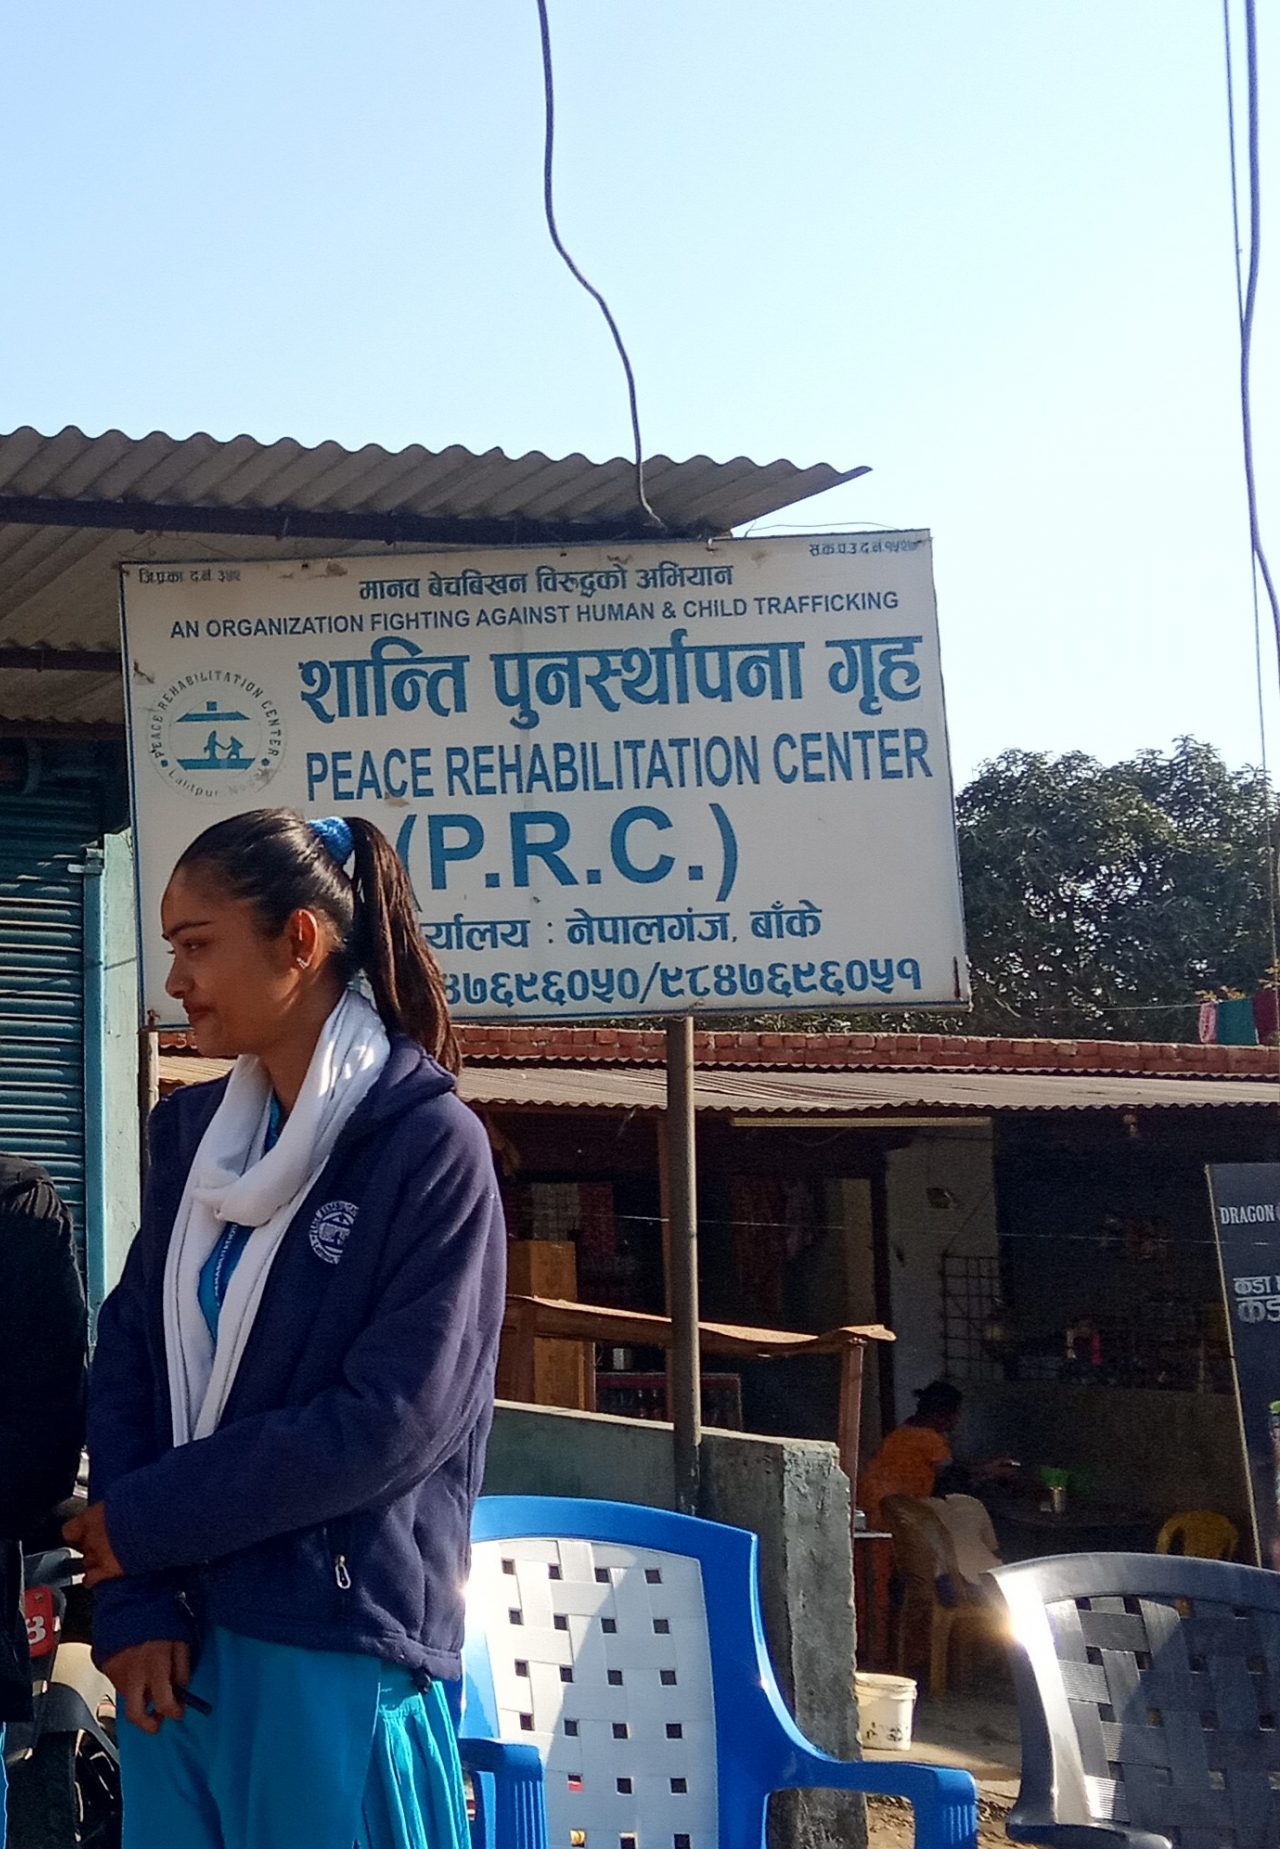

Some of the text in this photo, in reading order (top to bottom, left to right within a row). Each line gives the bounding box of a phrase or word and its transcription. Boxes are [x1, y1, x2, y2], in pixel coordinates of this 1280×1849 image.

[359, 577, 421, 601] मानव
[428, 569, 528, 598] बेचबिखन
[636, 560, 734, 590] अभियान
[170, 590, 899, 639] AN ORGANIZATION FIGHTING AGAINST HUMAN & CHILD TRAFFICKING
[298, 636, 470, 725] शान्ति
[824, 635, 923, 716] गृह
[150, 670, 282, 759] PEACE REHABILITATION CENTER
[306, 747, 433, 801] PEACE
[446, 735, 760, 797] REHABILITATION
[772, 727, 933, 784] CENTER
[750, 899, 823, 940] बाँके
[1220, 1204, 1275, 1224] DRAGON
